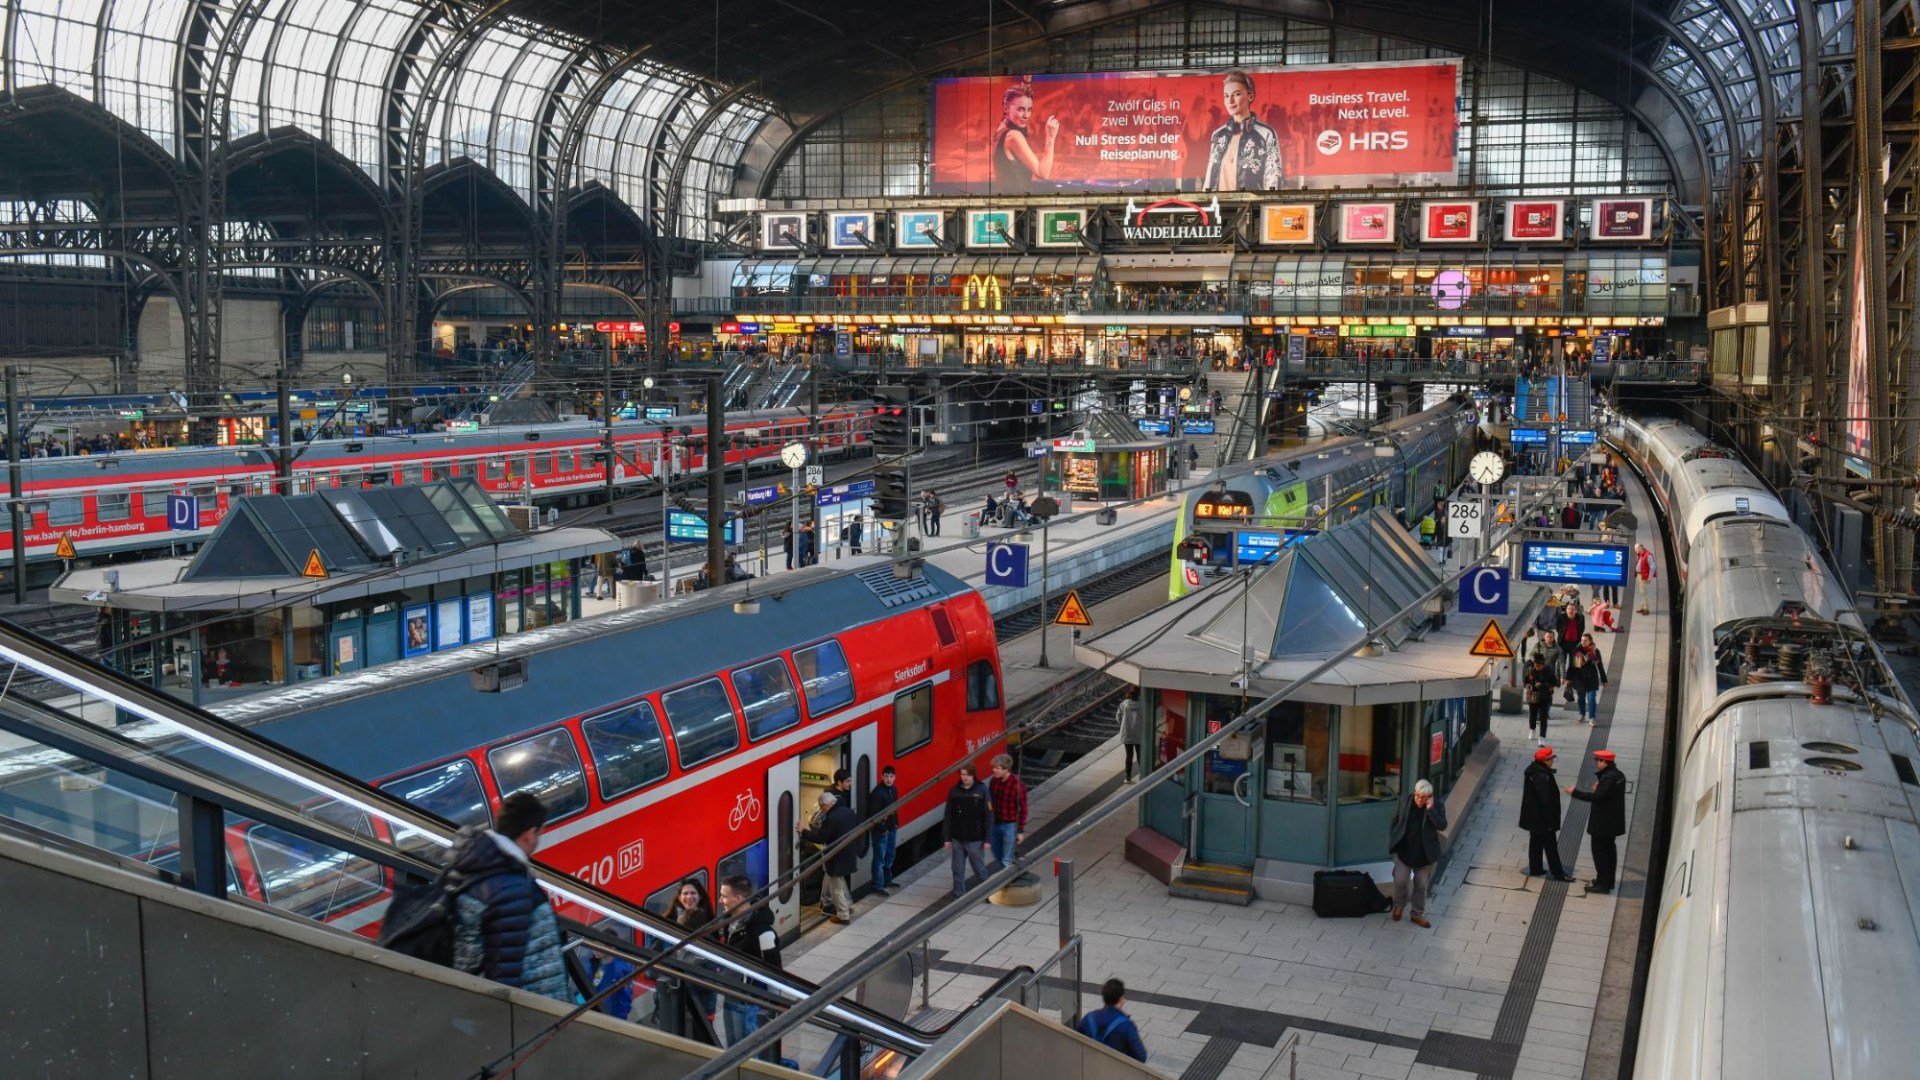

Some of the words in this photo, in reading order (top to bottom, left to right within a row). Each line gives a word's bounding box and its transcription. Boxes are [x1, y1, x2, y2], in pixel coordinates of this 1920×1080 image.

[1309, 92, 1363, 105] Business
[1367, 89, 1410, 103] Travel.
[1107, 99, 1141, 112] Zwölf
[1142, 98, 1167, 112] Gigs
[1169, 98, 1180, 110] in
[1102, 115, 1128, 126] zwei
[1133, 113, 1182, 126] Wochen.
[1338, 108, 1368, 120] Next
[1372, 106, 1410, 118] Level.
[1075, 134, 1098, 146] Null
[1101, 133, 1136, 145] Stress
[1138, 131, 1157, 144] bei
[1160, 131, 1180, 144] der
[1349, 130, 1409, 150] HRS
[1100, 148, 1181, 161] Reiseplanung.
[1123, 226, 1222, 239] WANDELHALLE
[808, 466, 822, 475] 286
[812, 476, 817, 484] 6
[175, 498, 189, 524] D
[1452, 504, 1478, 518] 286
[1460, 520, 1470, 534] 6
[992, 544, 1012, 577] C
[1615, 552, 1623, 561] 5
[1474, 568, 1500, 604] C
[894, 660, 926, 683] Sierksdorf
[620, 845, 641, 872] DB
